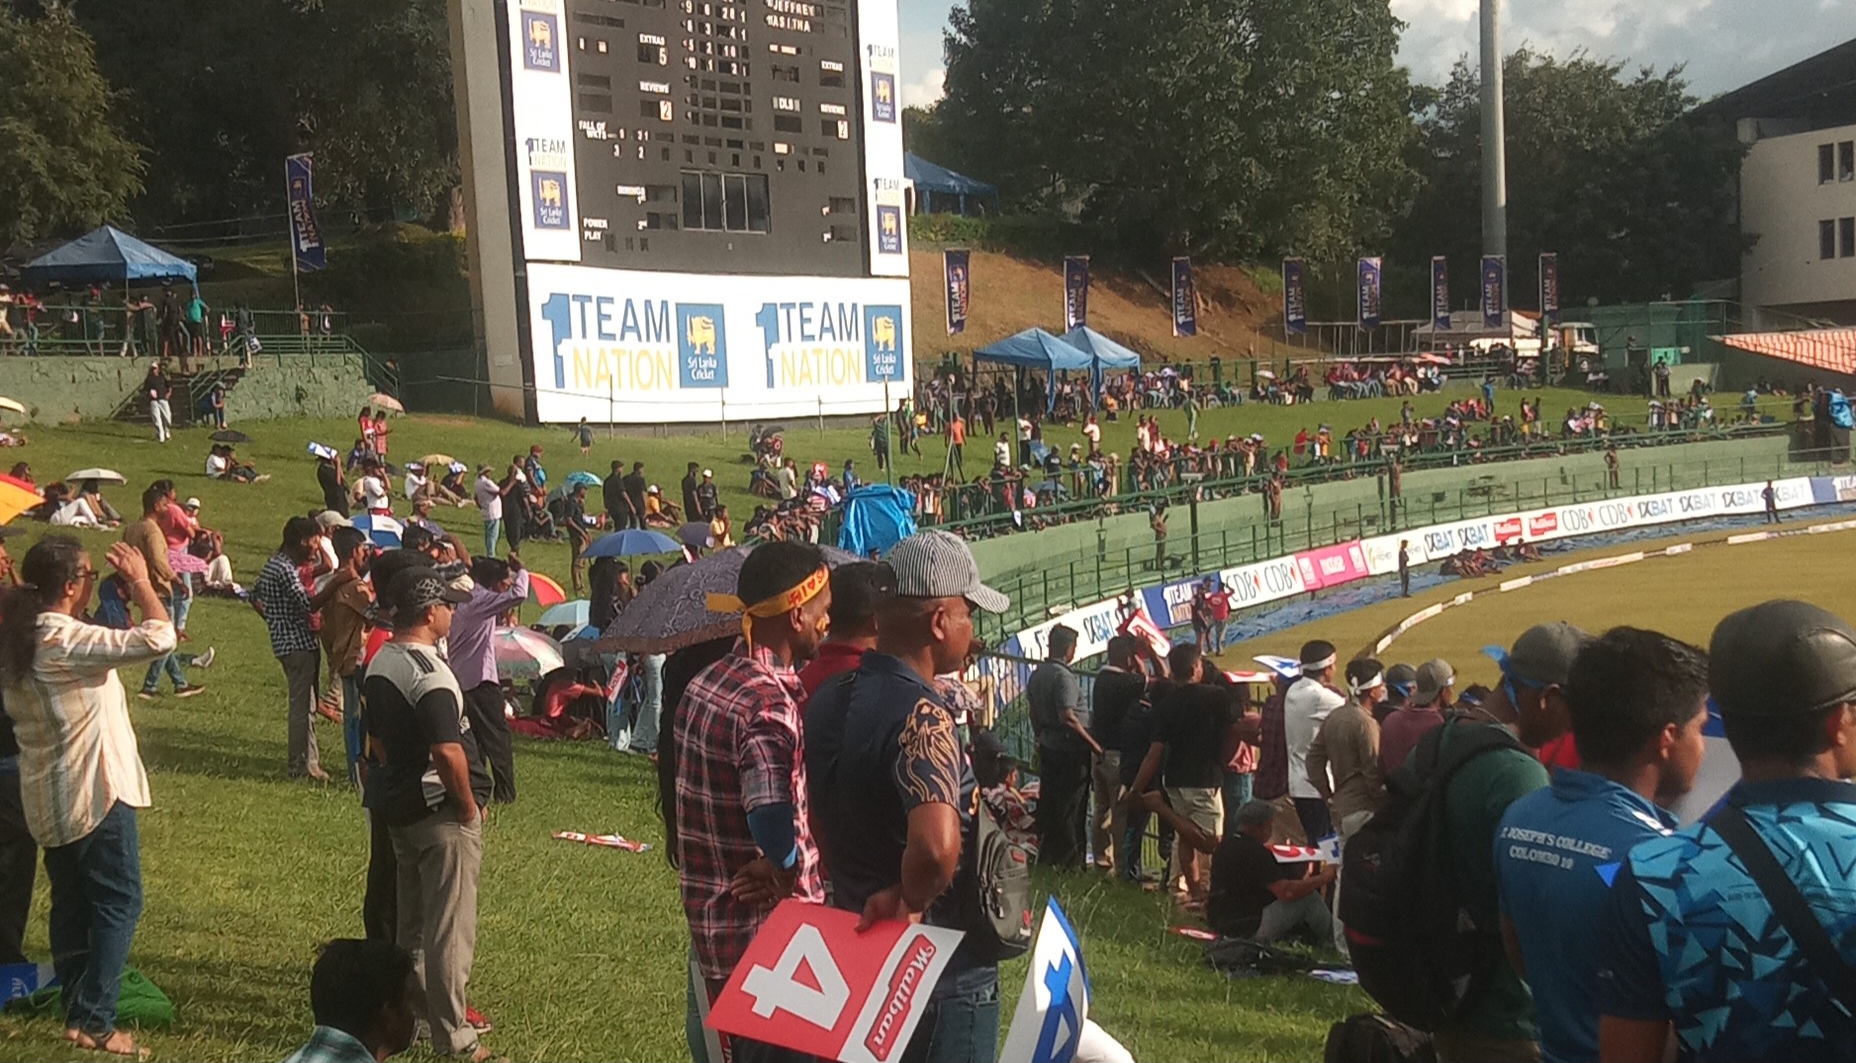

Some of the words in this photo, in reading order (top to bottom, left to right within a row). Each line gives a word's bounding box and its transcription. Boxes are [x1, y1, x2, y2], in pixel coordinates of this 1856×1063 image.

[773, 15, 811, 33] ASITHA
[639, 33, 665, 46] EXTRAS
[533, 138, 565, 154] TEAM
[572, 294, 670, 343] TEAM
[780, 302, 858, 342] TEAM
[573, 347, 673, 390] NATION
[687, 357, 698, 369] Sri
[699, 357, 717, 368] Lanka
[781, 348, 861, 387] NATION
[873, 354, 881, 364] Sri
[882, 354, 896, 363] Lanka
[876, 364, 894, 374] Cricket
[691, 368, 714, 380] Cricket
[1562, 508, 1589, 532] CDB
[1599, 503, 1628, 526] CDB
[1226, 571, 1256, 604] CDB
[1264, 563, 1292, 593] CDB
[1508, 827, 1556, 846] JOSEPH'S
[1556, 836, 1613, 859] COLLEGE
[1509, 845, 1560, 866] COLOMBO
[740, 922, 850, 1033] 4
[873, 944, 936, 1046] Maliban
